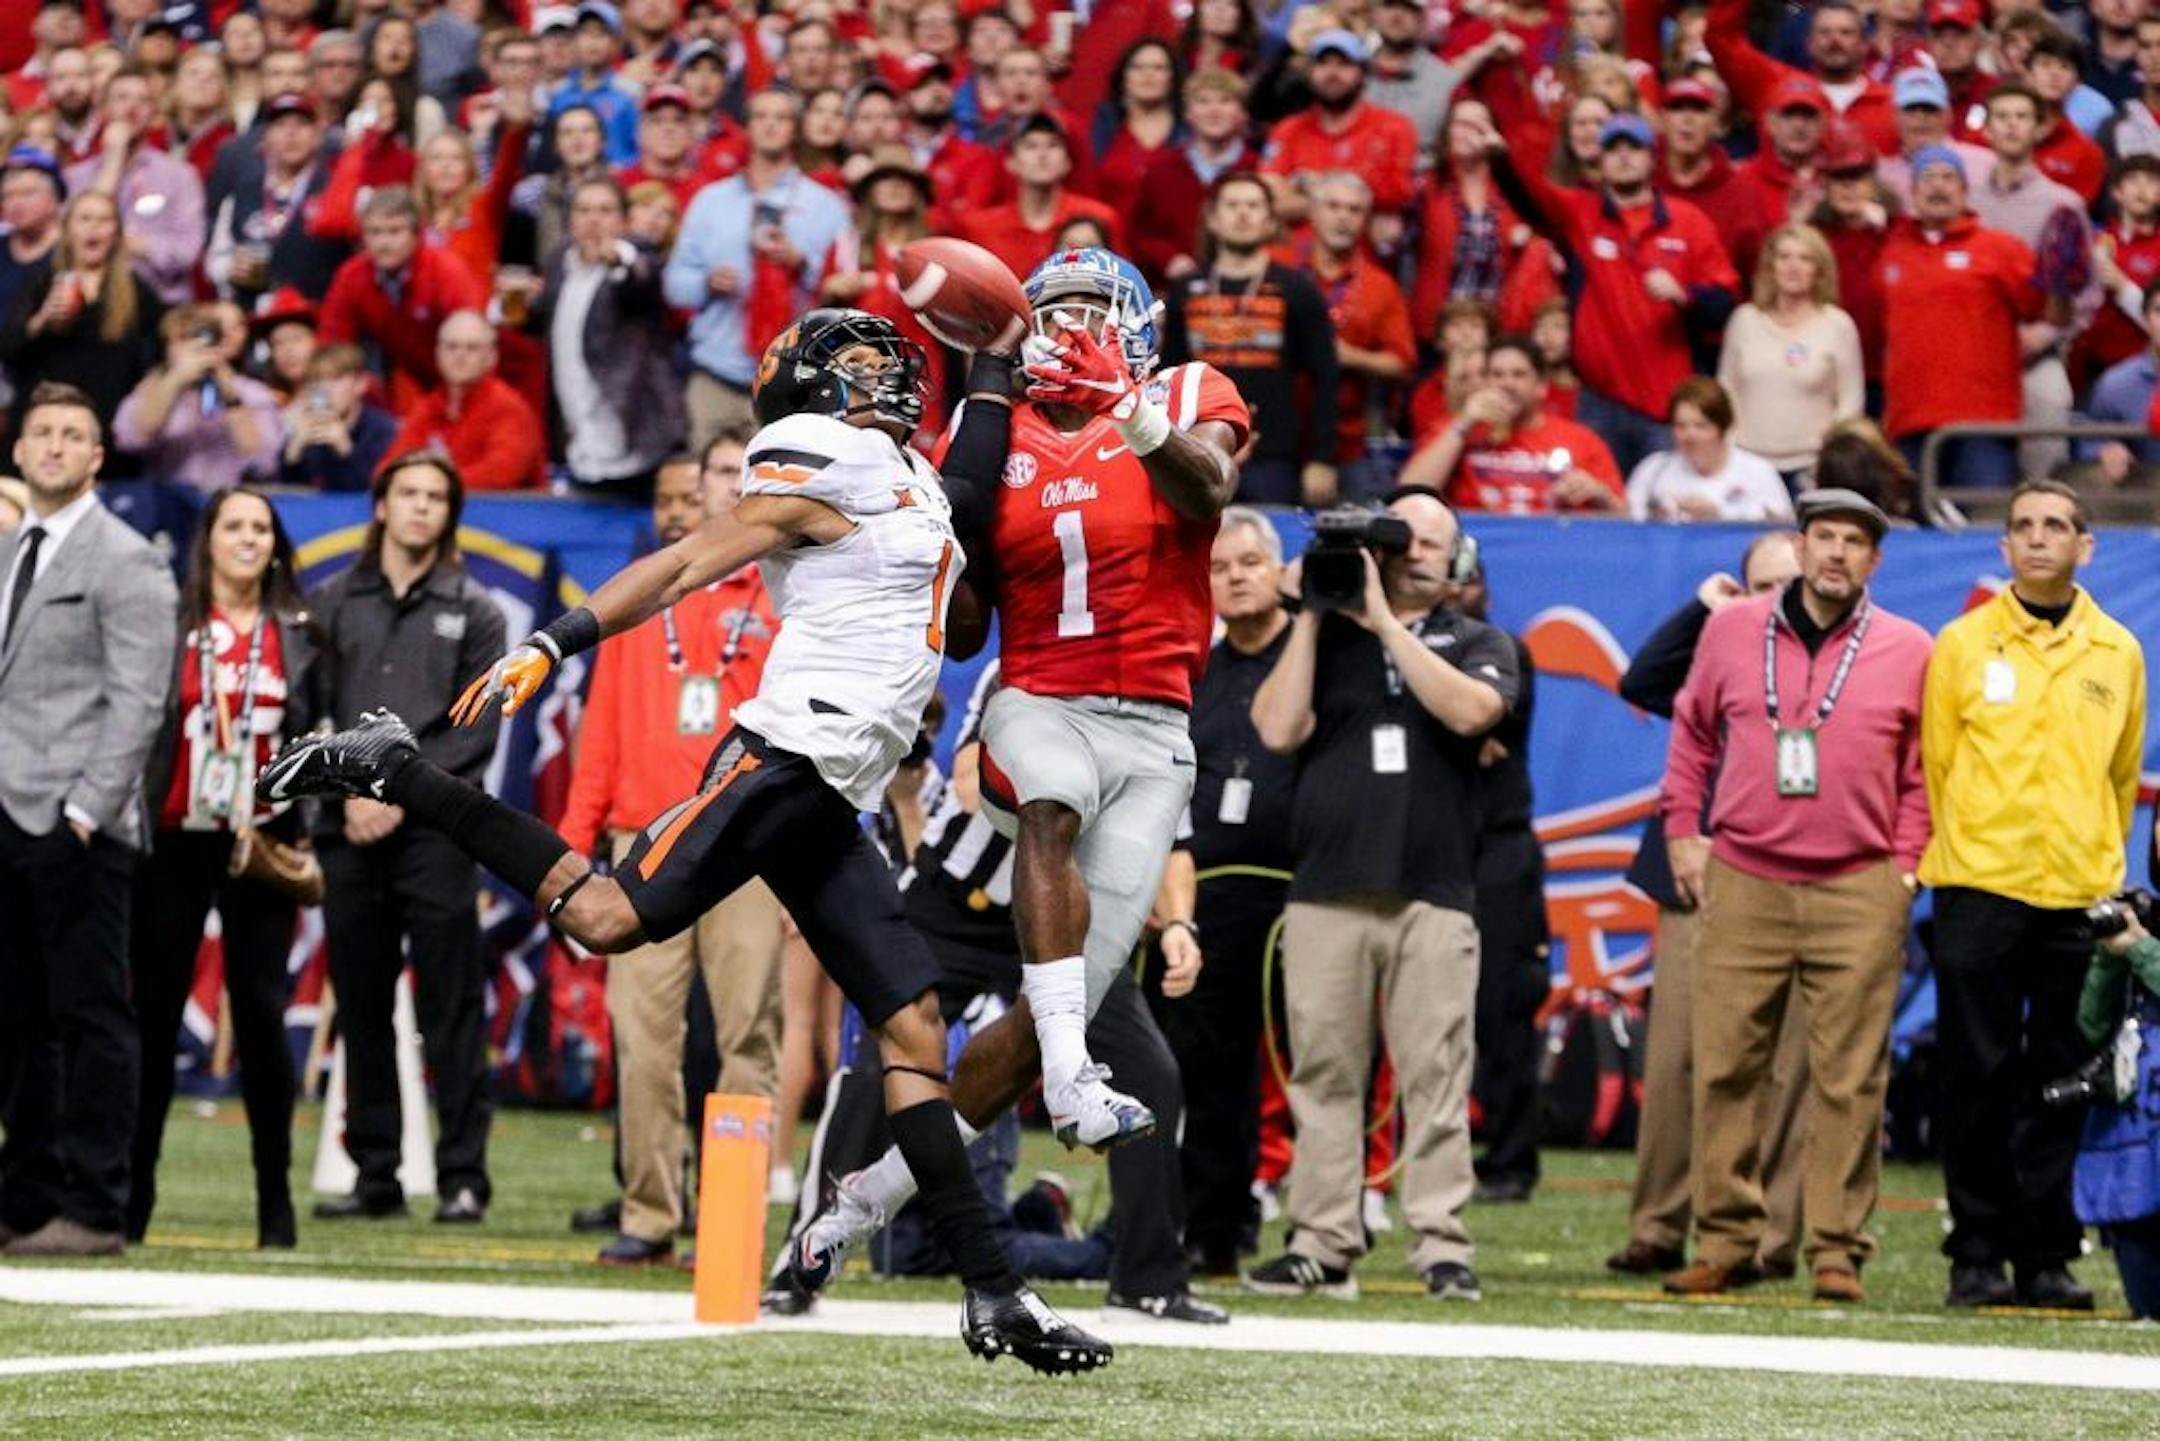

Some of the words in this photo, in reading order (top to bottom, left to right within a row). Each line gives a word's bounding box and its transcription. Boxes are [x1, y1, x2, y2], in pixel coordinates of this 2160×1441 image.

[1005, 453, 1035, 486] SEC
[1041, 481, 1063, 507] Ole
[1062, 476, 1099, 503] Miss
[926, 537, 954, 655] 1
[1053, 510, 1095, 637] 1
